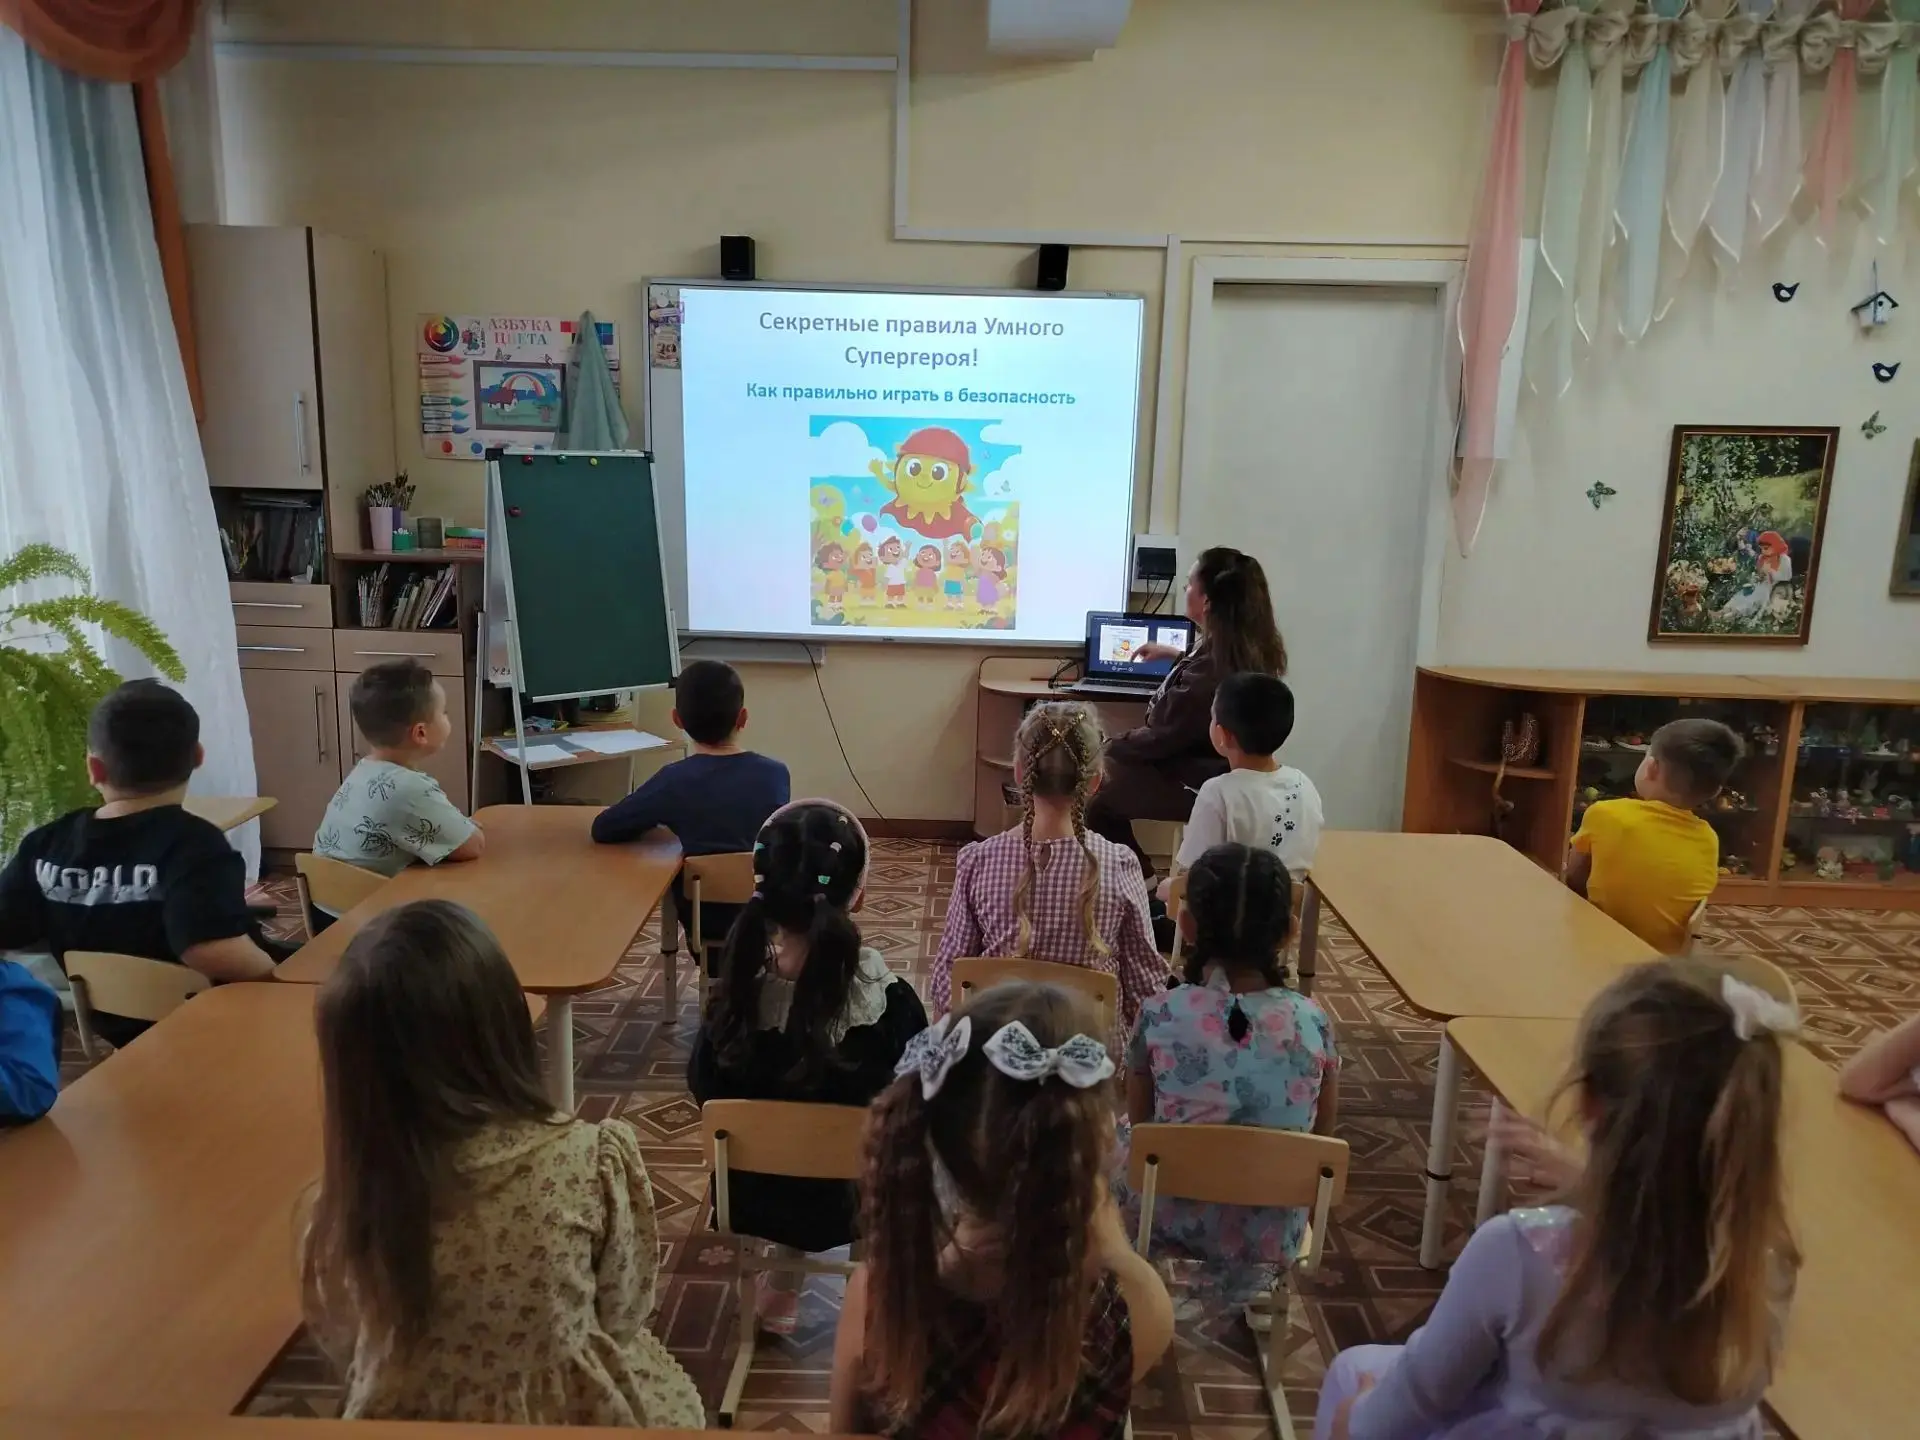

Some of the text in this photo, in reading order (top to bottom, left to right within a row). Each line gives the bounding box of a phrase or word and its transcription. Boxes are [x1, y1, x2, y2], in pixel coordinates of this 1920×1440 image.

[489, 318, 553, 332] АЗБУКА
[759, 312, 1064, 336] Секретные правила Умного
[494, 333, 548, 345] ЦЕТА
[845, 346, 978, 369] Супергероя!
[747, 382, 1076, 405] Как правильно играть в безопасность
[35, 858, 160, 906] WORLD
